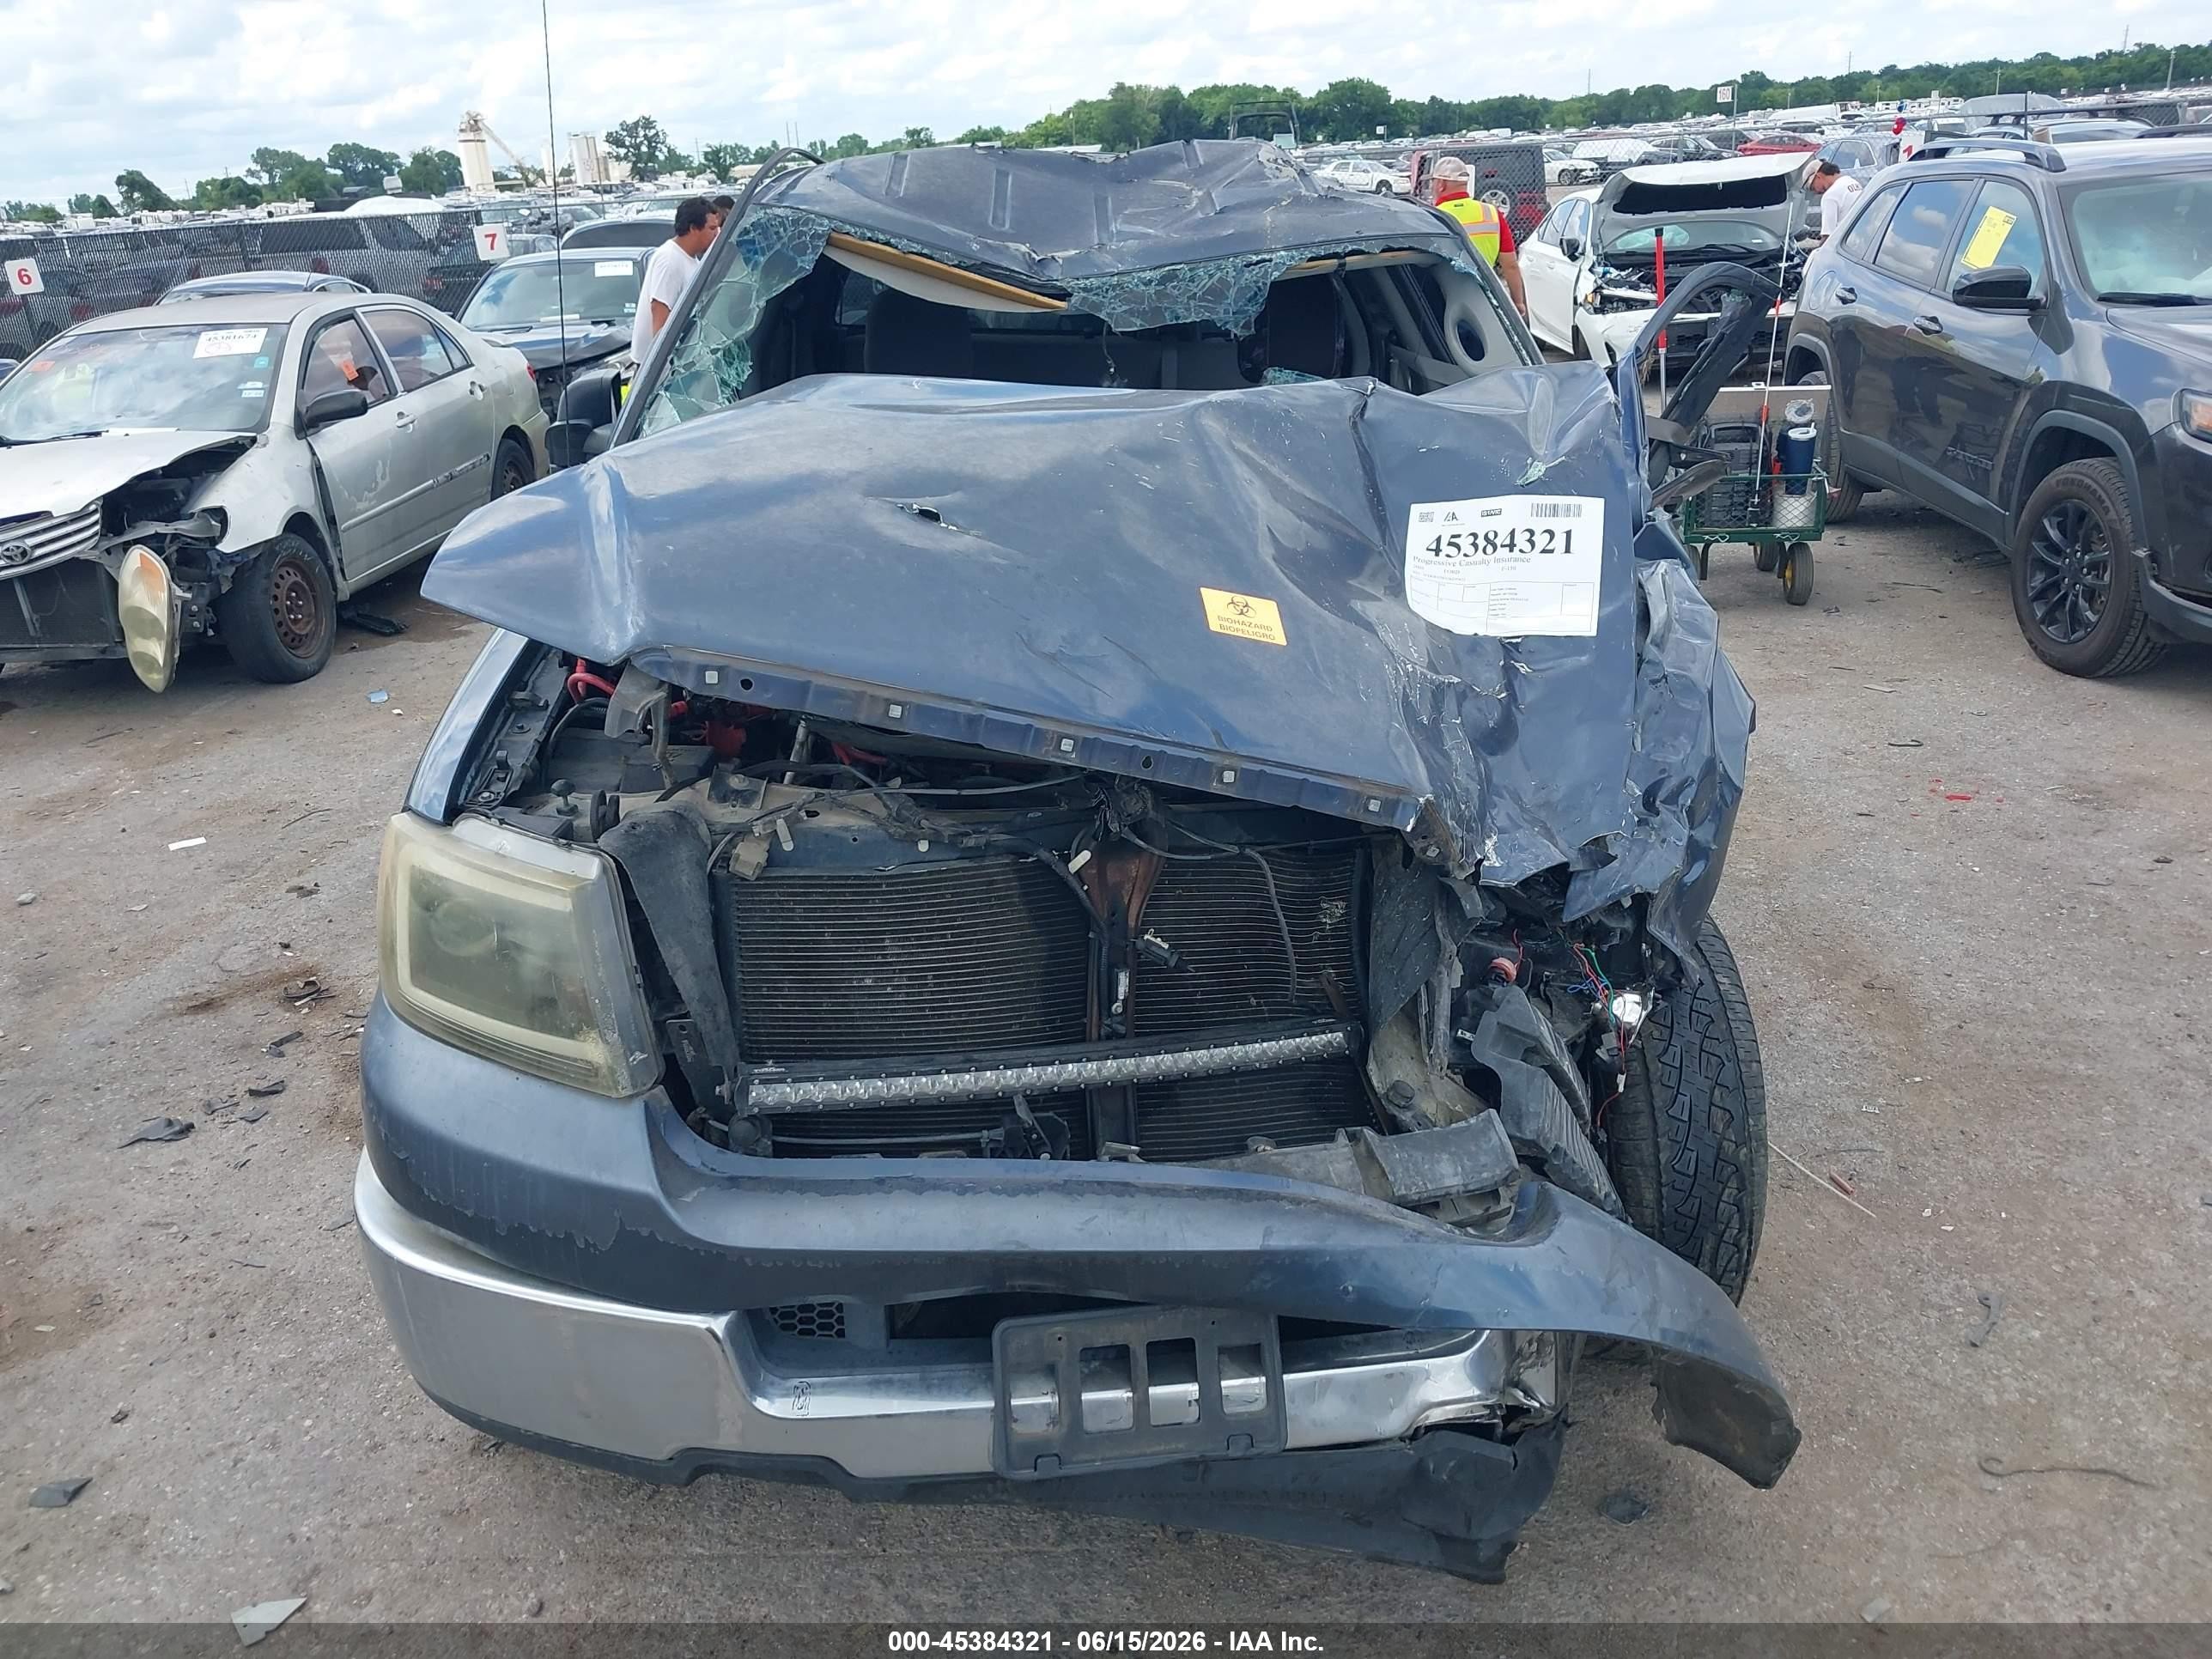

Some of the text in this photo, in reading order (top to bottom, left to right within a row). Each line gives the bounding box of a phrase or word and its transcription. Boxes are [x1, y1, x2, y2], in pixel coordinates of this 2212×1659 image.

[1719, 88, 1730, 100] 160
[484, 233, 496, 251] 7
[17, 268, 32, 285] 6
[1426, 528, 1576, 558] 45384321
[1413, 556, 1456, 568] Progressive
[1459, 557, 1492, 568] Casualty
[1493, 556, 1531, 565] Insurance
[1218, 616, 1273, 633] BIOHAZARD
[1219, 624, 1276, 641] BIOPELIGRO
